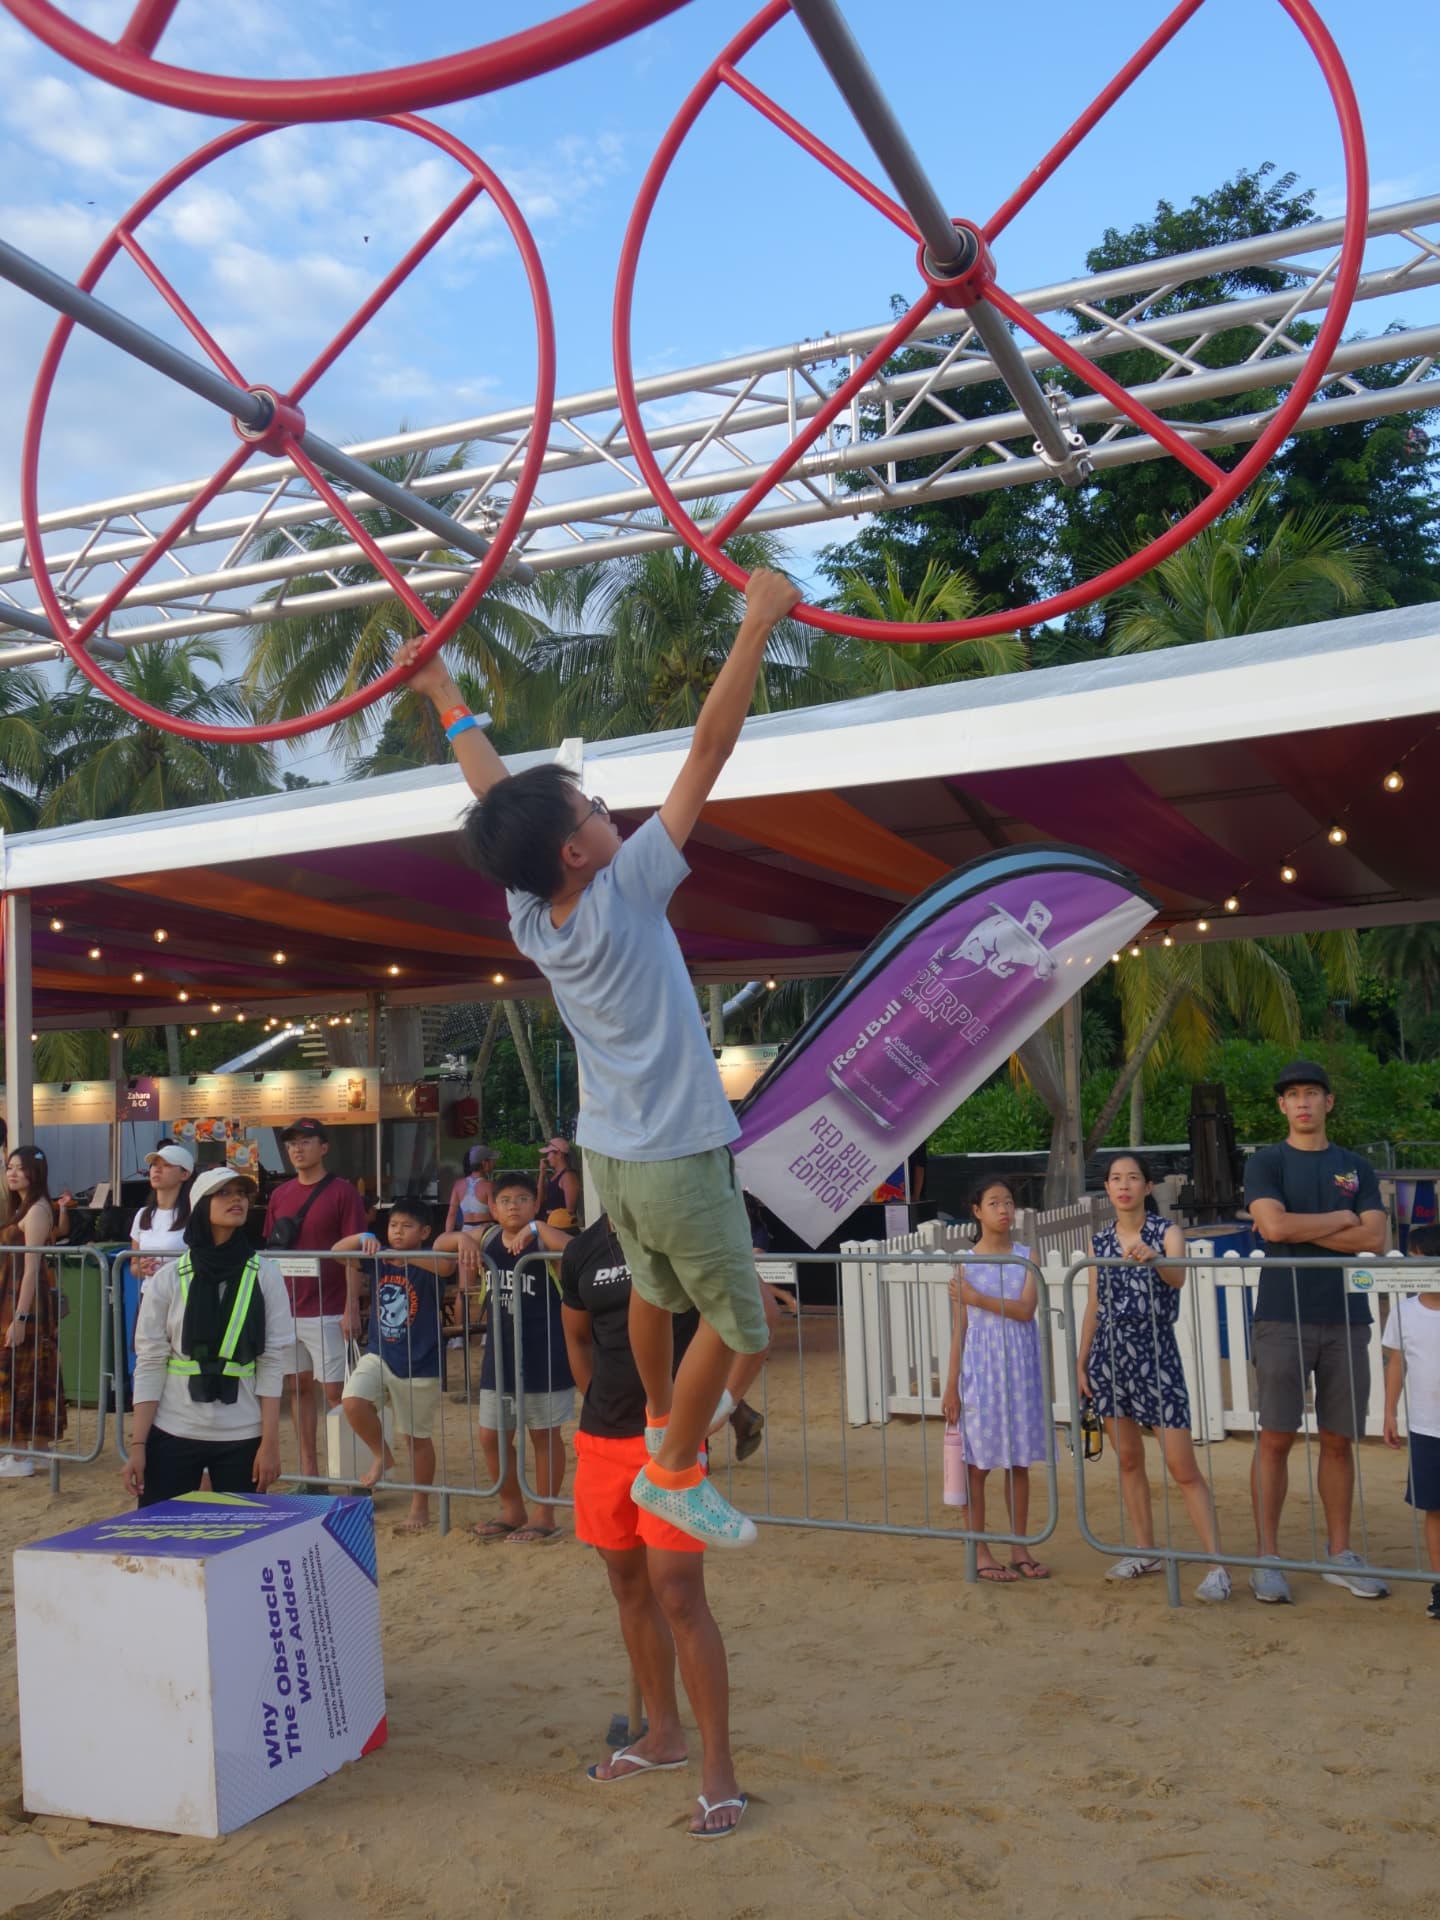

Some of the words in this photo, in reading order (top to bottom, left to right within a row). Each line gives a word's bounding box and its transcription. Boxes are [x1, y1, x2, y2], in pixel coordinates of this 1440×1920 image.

[928, 961, 943, 976] THE
[833, 1033, 869, 1071] Red
[865, 999, 902, 1037] Bull
[901, 986, 938, 1023] EDITION
[909, 969, 990, 1046] PURPLE
[127, 1092, 151, 1100] Zahara
[807, 1142, 864, 1198] PURPLE
[809, 1115, 843, 1148] RED
[838, 1142, 877, 1183] BULL
[788, 1155, 849, 1213] EDITION
[261, 1567, 291, 1696] Obstacle
[277, 1560, 302, 1641] Added
[262, 1702, 282, 1769] Why
[284, 1704, 302, 1759] The
